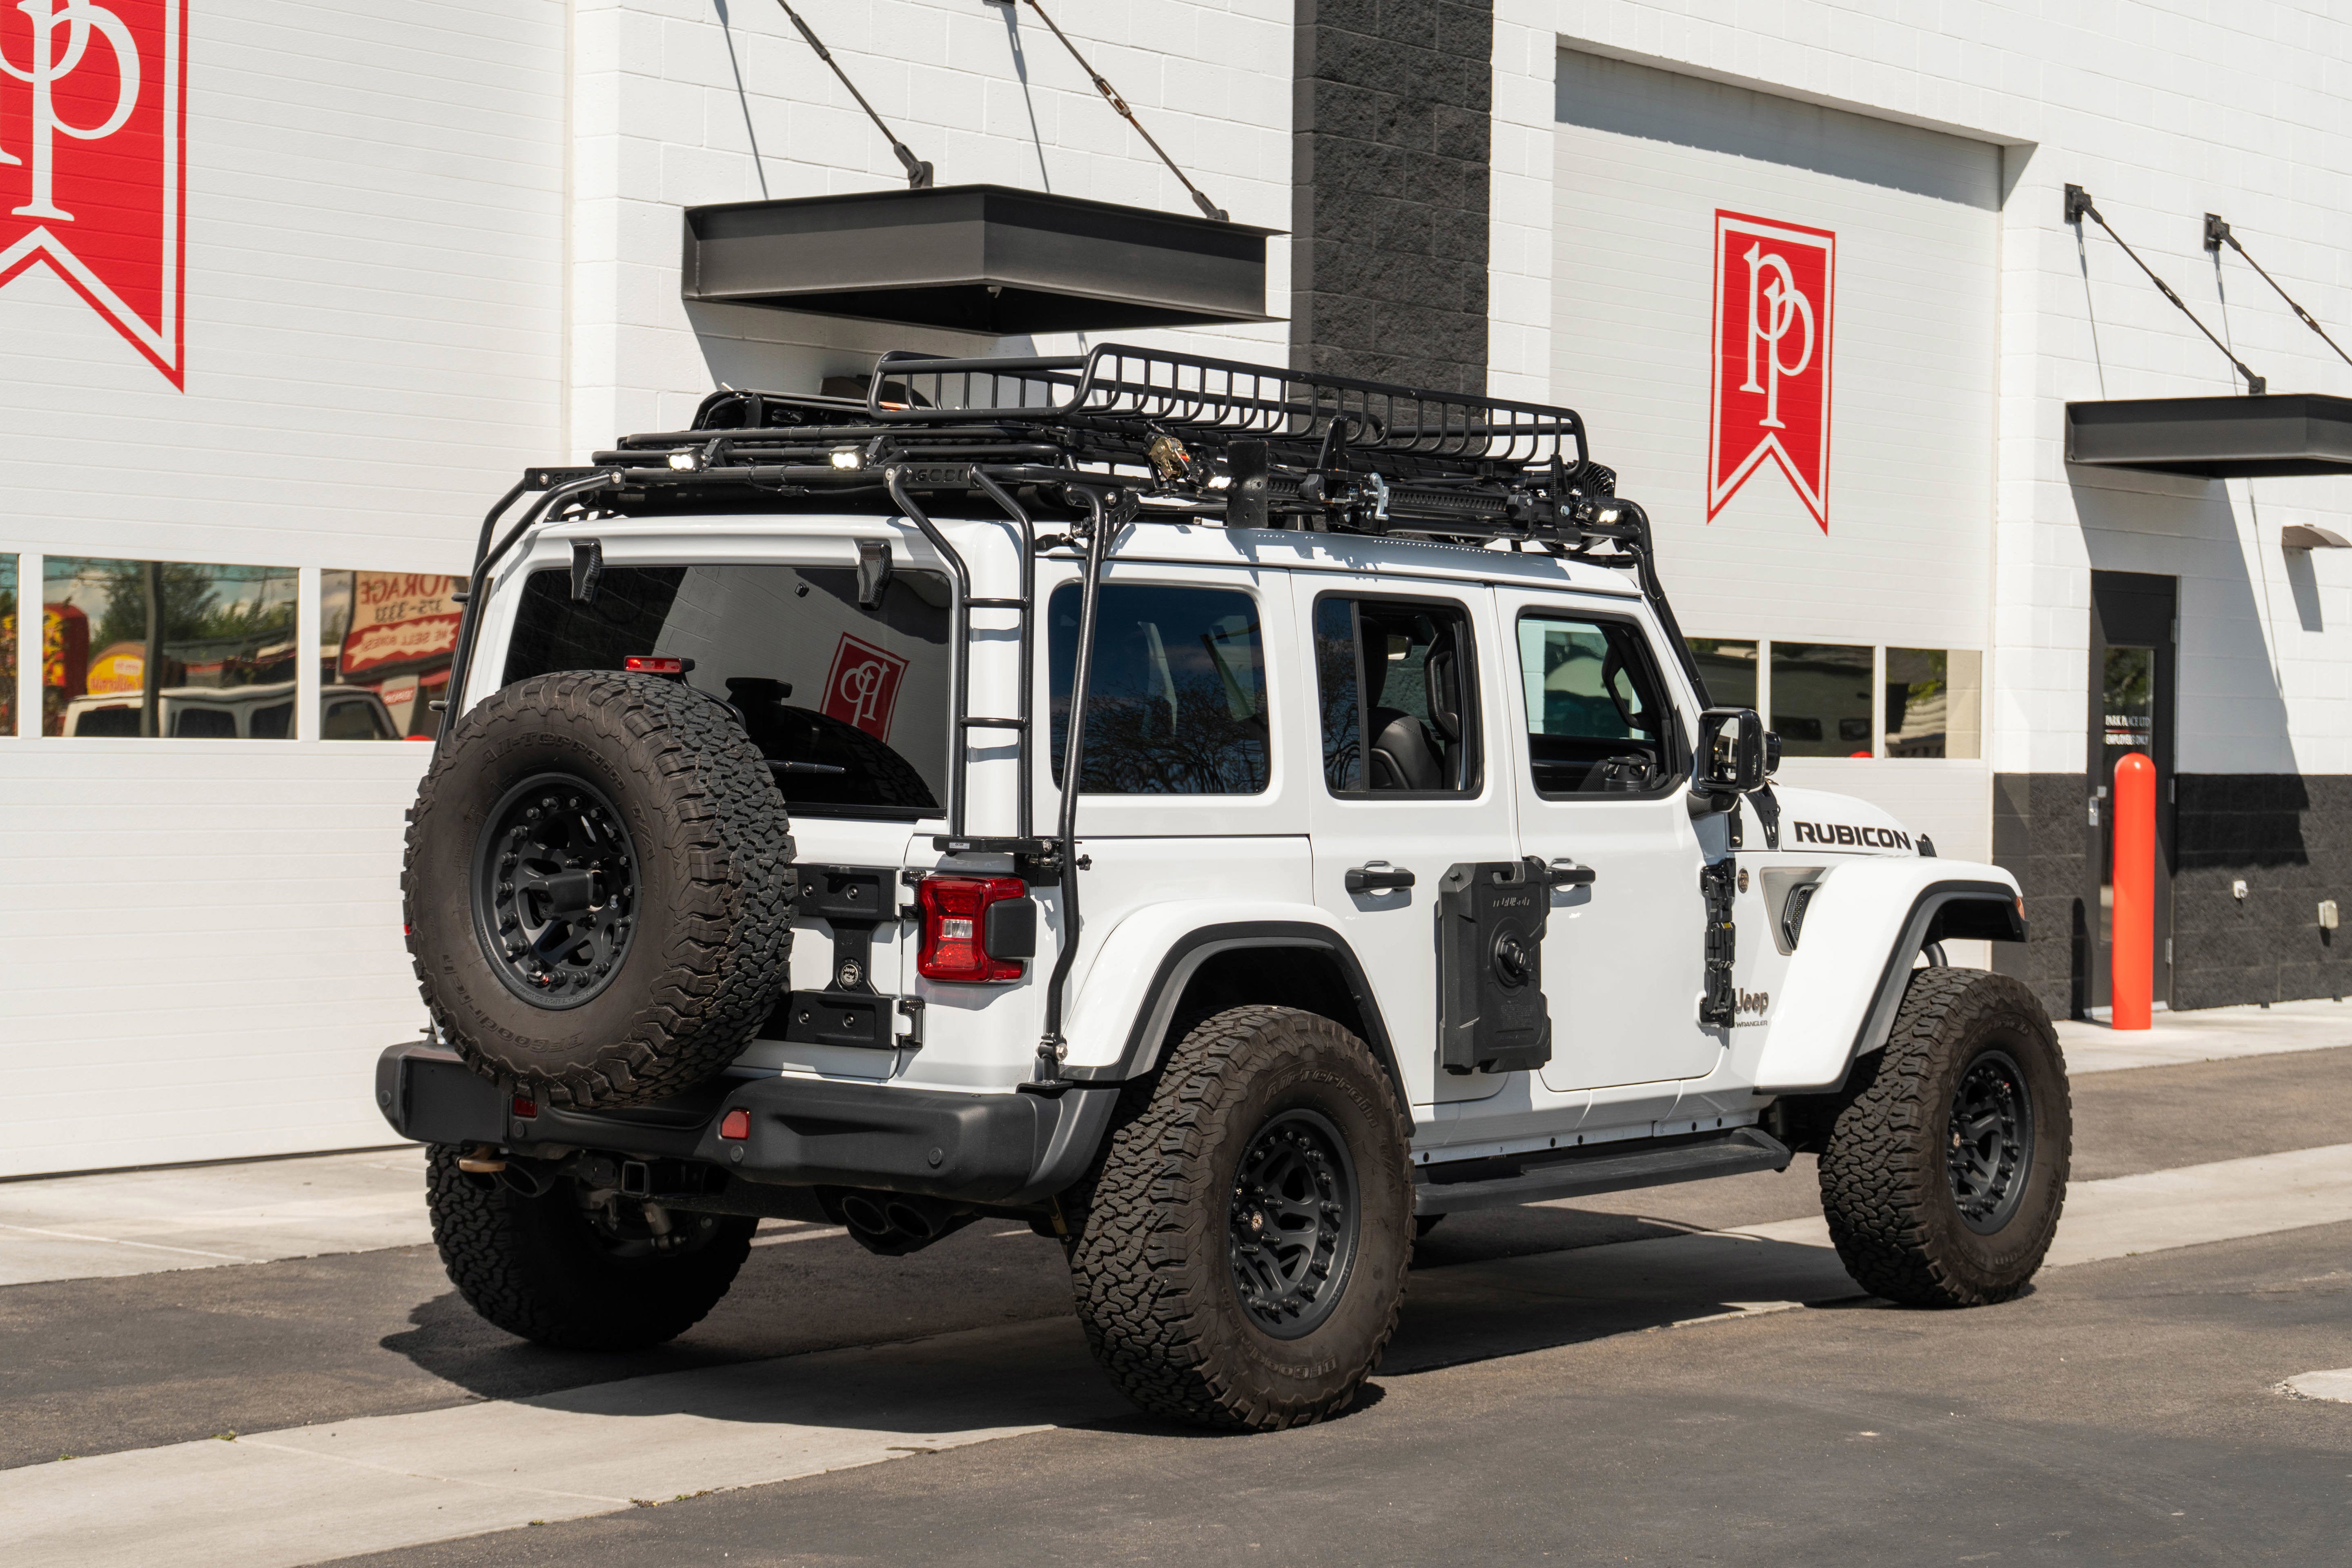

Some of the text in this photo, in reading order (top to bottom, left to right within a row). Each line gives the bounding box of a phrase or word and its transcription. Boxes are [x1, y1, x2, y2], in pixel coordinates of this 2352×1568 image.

[916, 469, 963, 483] GOBI
[2105, 715, 2121, 726] PARK
[2121, 715, 2139, 727] PLACE
[2106, 734, 2149, 745] EMPLOYEES ONLY
[1793, 820, 1912, 850] RUBICON
[1734, 987, 1769, 1017] Jeep
